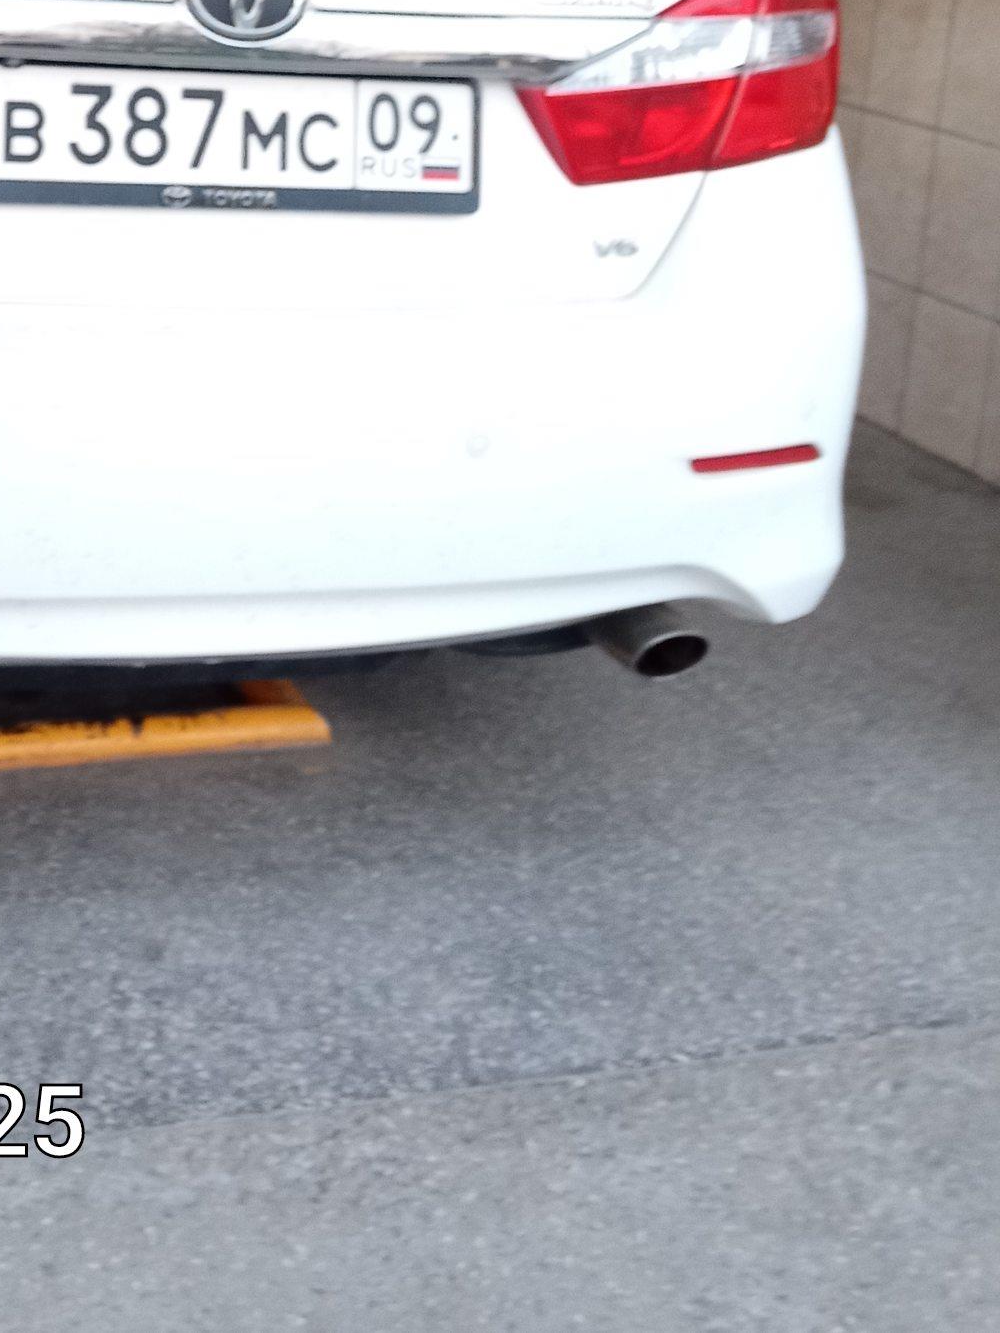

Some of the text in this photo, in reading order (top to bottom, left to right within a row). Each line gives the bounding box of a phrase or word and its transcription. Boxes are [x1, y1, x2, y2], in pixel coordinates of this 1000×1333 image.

[368, 93, 441, 154] 09
[360, 155, 418, 179] RUS
[202, 188, 277, 210] TOYOTA
